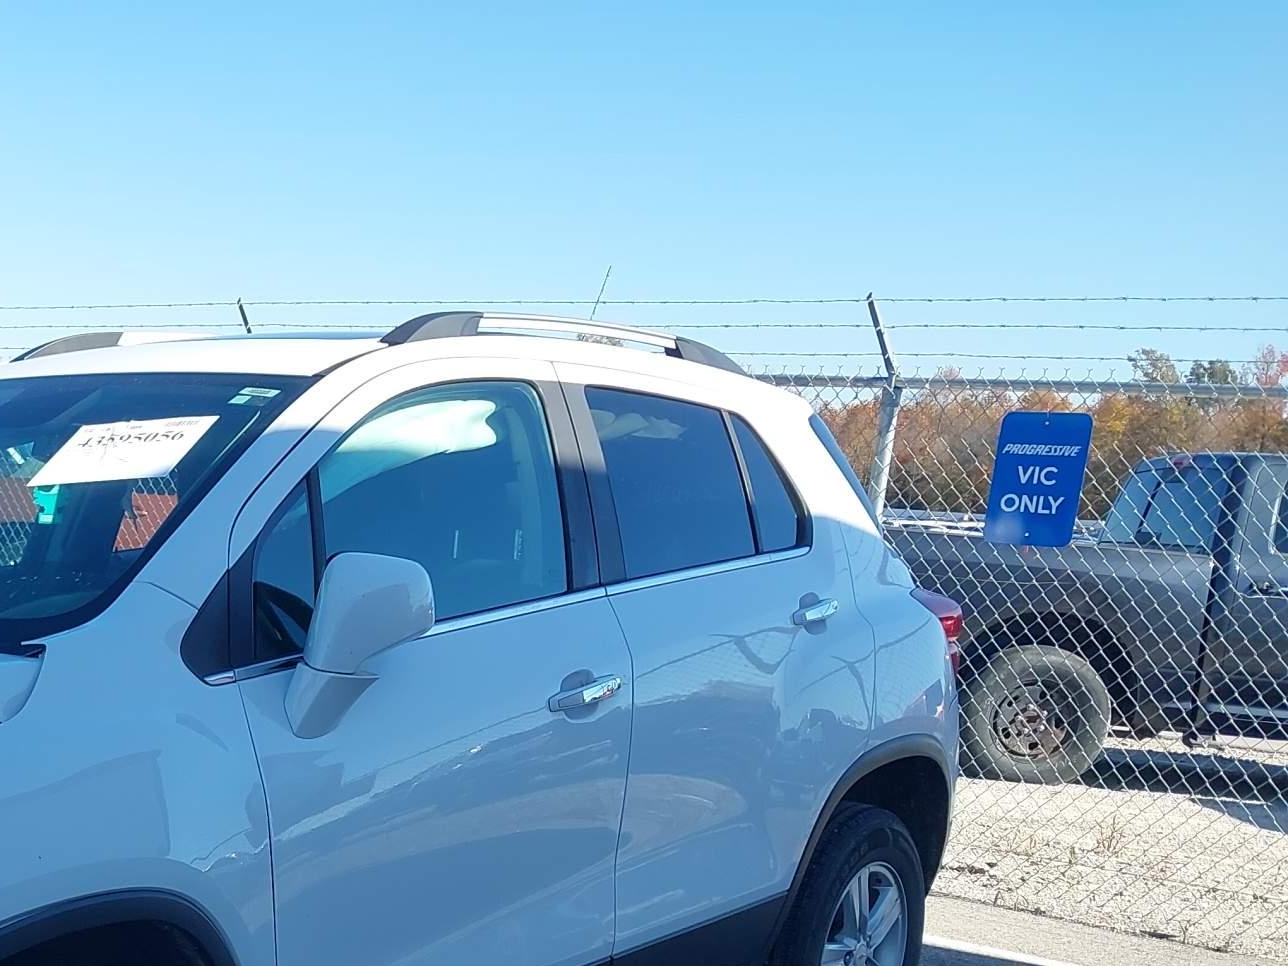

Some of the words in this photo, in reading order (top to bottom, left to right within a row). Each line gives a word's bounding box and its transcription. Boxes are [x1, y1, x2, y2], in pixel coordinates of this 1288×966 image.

[1002, 444, 1082, 457] PROGRESSIVE
[1017, 466, 1059, 486] VIC
[1000, 494, 1065, 515] ONLY
